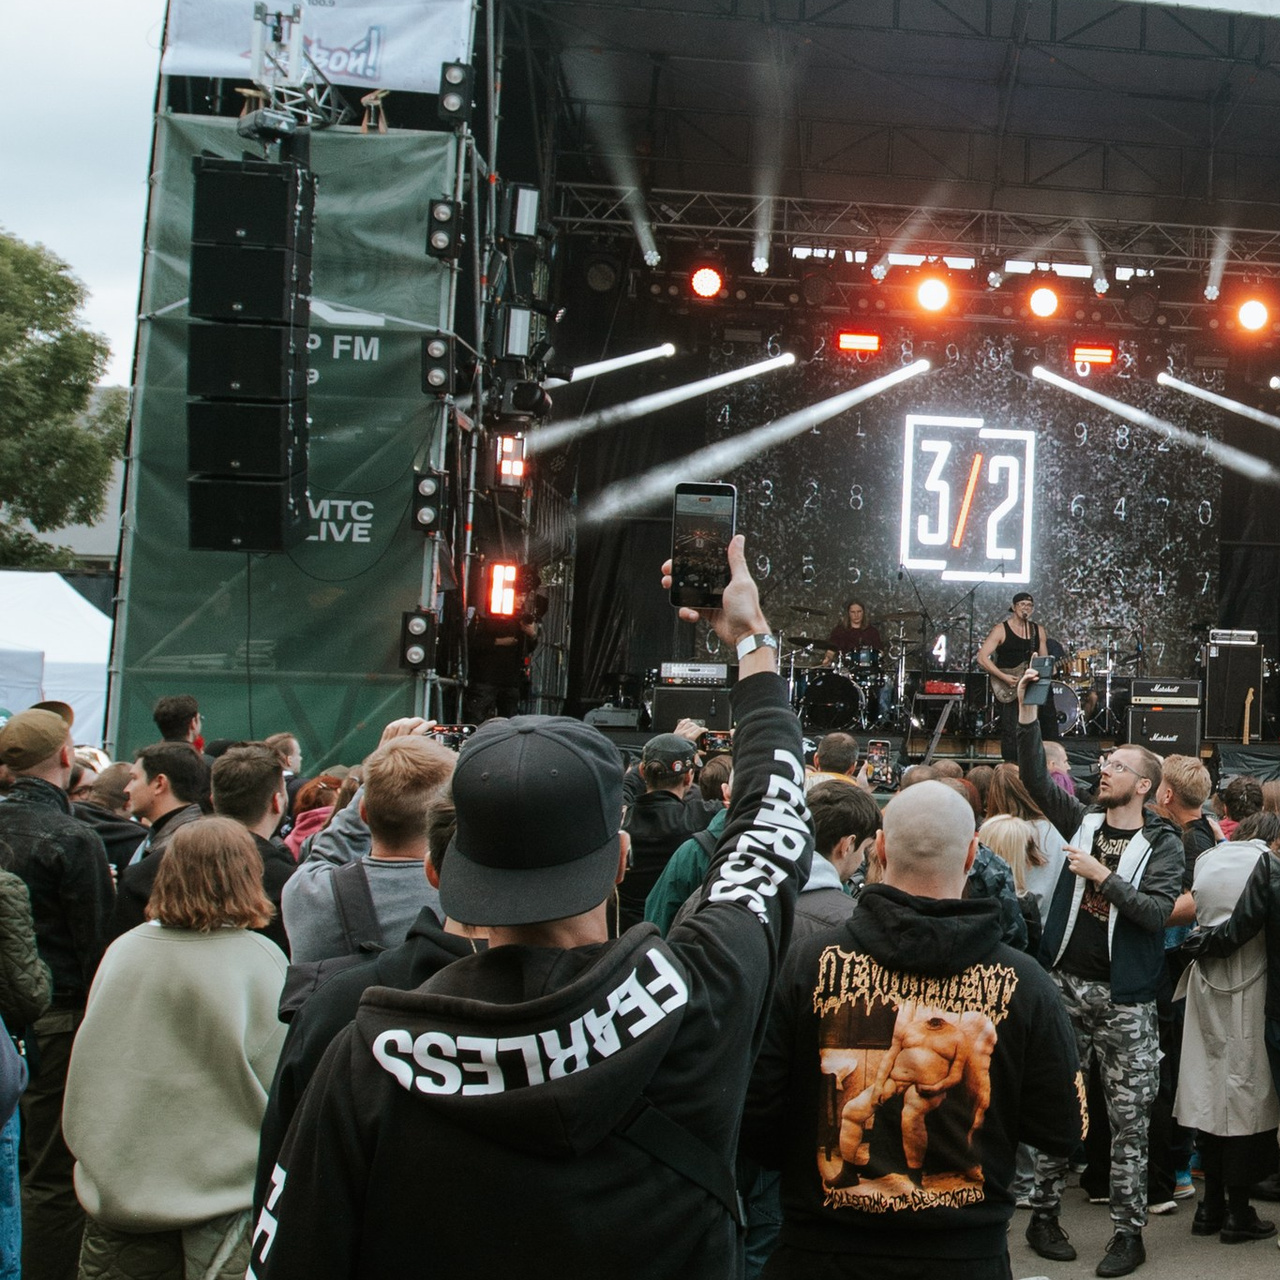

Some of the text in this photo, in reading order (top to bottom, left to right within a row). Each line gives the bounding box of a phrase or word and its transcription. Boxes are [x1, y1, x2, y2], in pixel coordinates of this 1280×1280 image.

[332, 334, 380, 361] FM
[917, 439, 1020, 561] 3/2
[932, 634, 947, 663] 4
[1150, 683, 1180, 693] Marshall
[1149, 732, 1179, 742] Marshall
[372, 947, 688, 1097] FEARLESS
